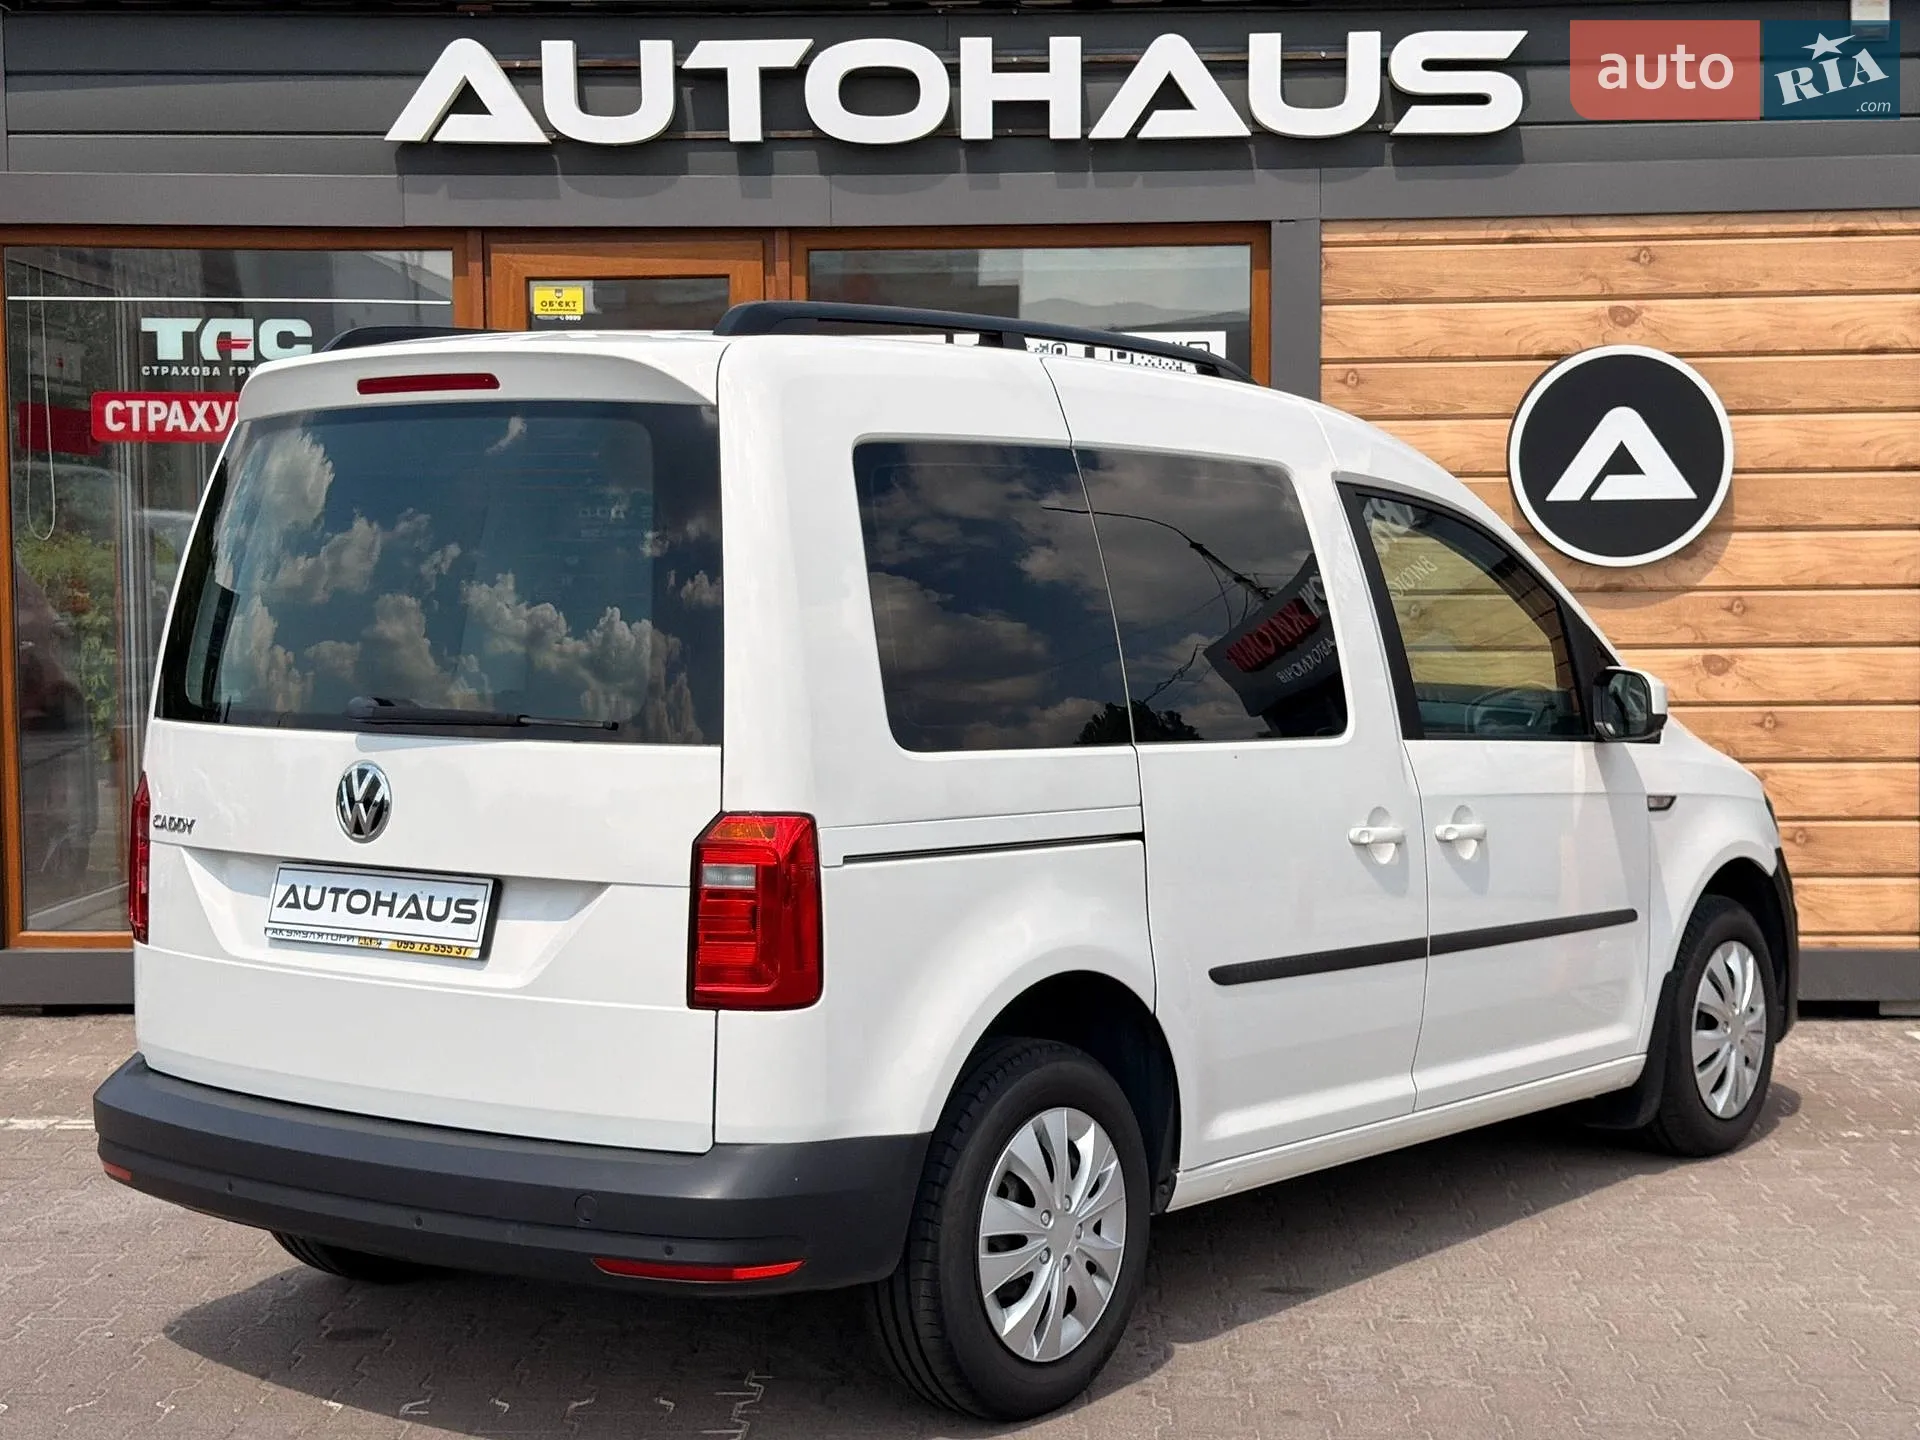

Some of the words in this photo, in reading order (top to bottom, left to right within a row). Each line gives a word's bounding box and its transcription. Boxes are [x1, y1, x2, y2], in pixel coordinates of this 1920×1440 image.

[384, 30, 1528, 146] AUTOHAUS
[141, 365, 221, 377] СТРАХОВА
[104, 399, 239, 433] СТРАХУ
[153, 814, 196, 835] CADDY
[276, 883, 479, 925] AUTOHAUS
